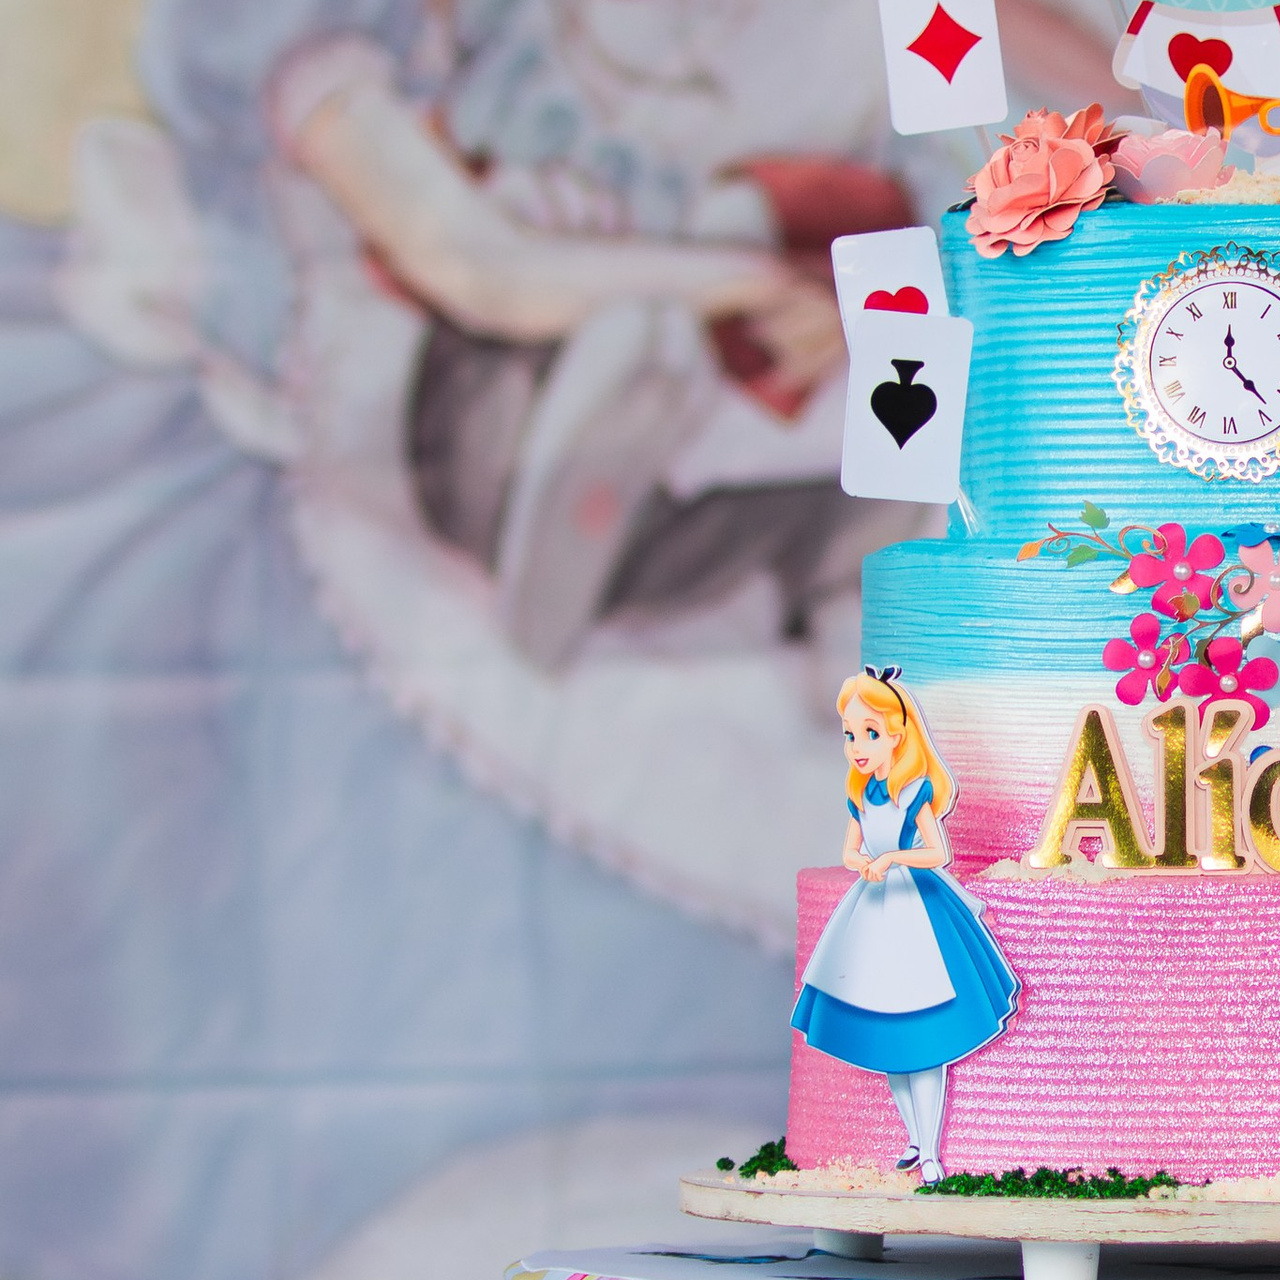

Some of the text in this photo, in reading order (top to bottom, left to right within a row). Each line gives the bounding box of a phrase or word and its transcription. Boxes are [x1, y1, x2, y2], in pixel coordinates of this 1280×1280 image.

[1222, 291, 1237, 309] XII
[1186, 302, 1203, 321] XI
[1166, 327, 1184, 340] X
[1187, 406, 1206, 428] VII
[1223, 416, 1237, 434] VI
[1258, 409, 1272, 426] V
